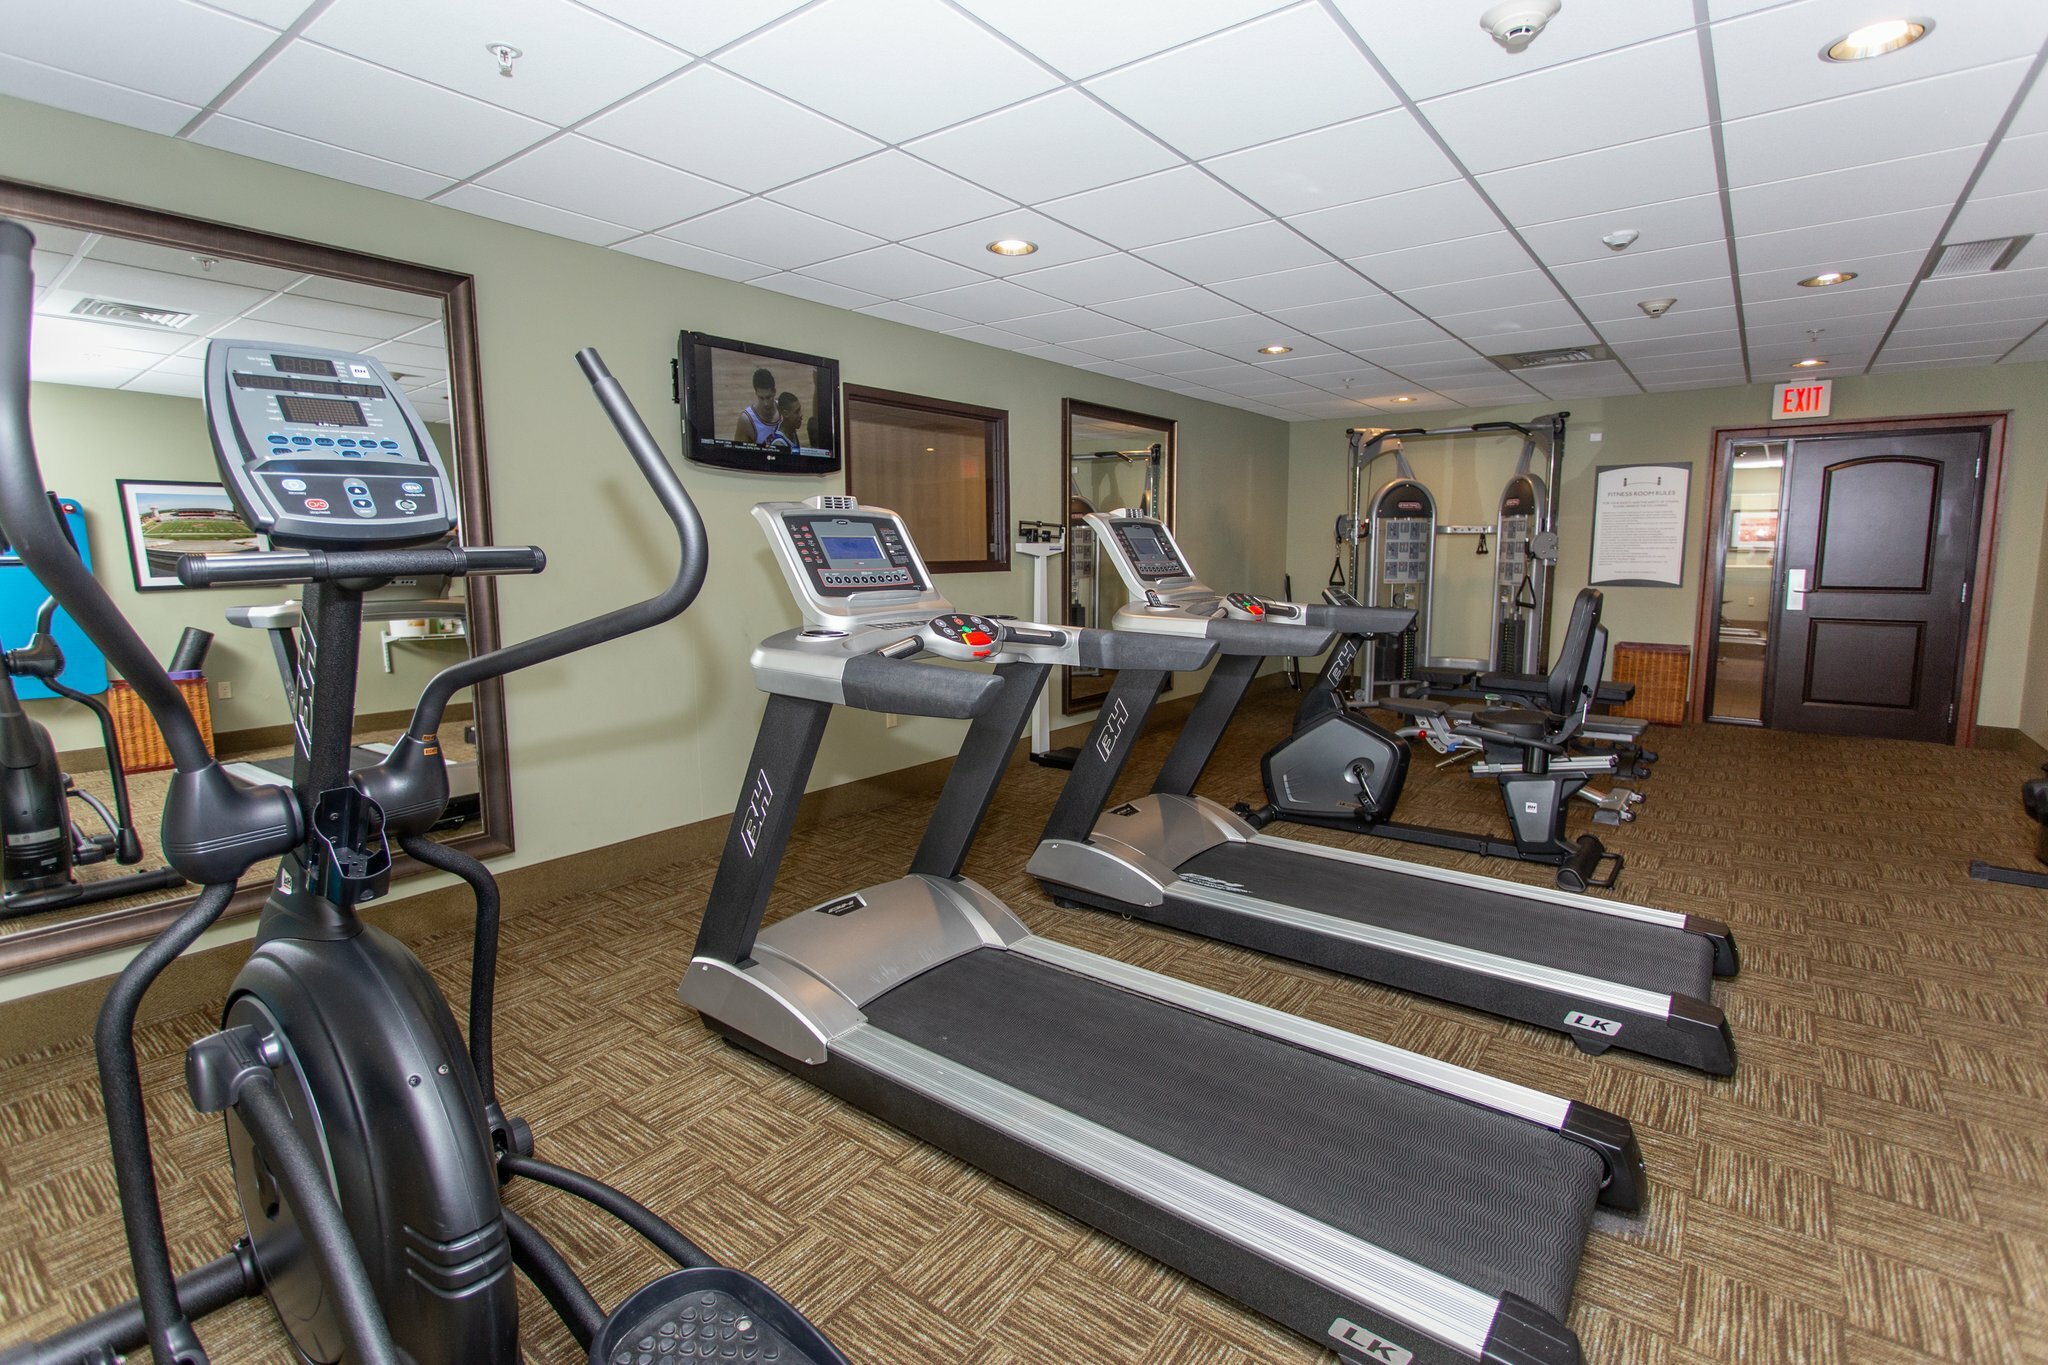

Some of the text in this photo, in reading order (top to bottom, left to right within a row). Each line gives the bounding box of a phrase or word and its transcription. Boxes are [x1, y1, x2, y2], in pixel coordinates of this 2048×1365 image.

[1783, 385, 1824, 413] EXIT
[1327, 640, 1357, 687] BH
[1095, 697, 1129, 763] BH
[740, 768, 773, 858] BH
[1574, 1015, 1612, 1032] LK
[1342, 1326, 1399, 1362] LK
